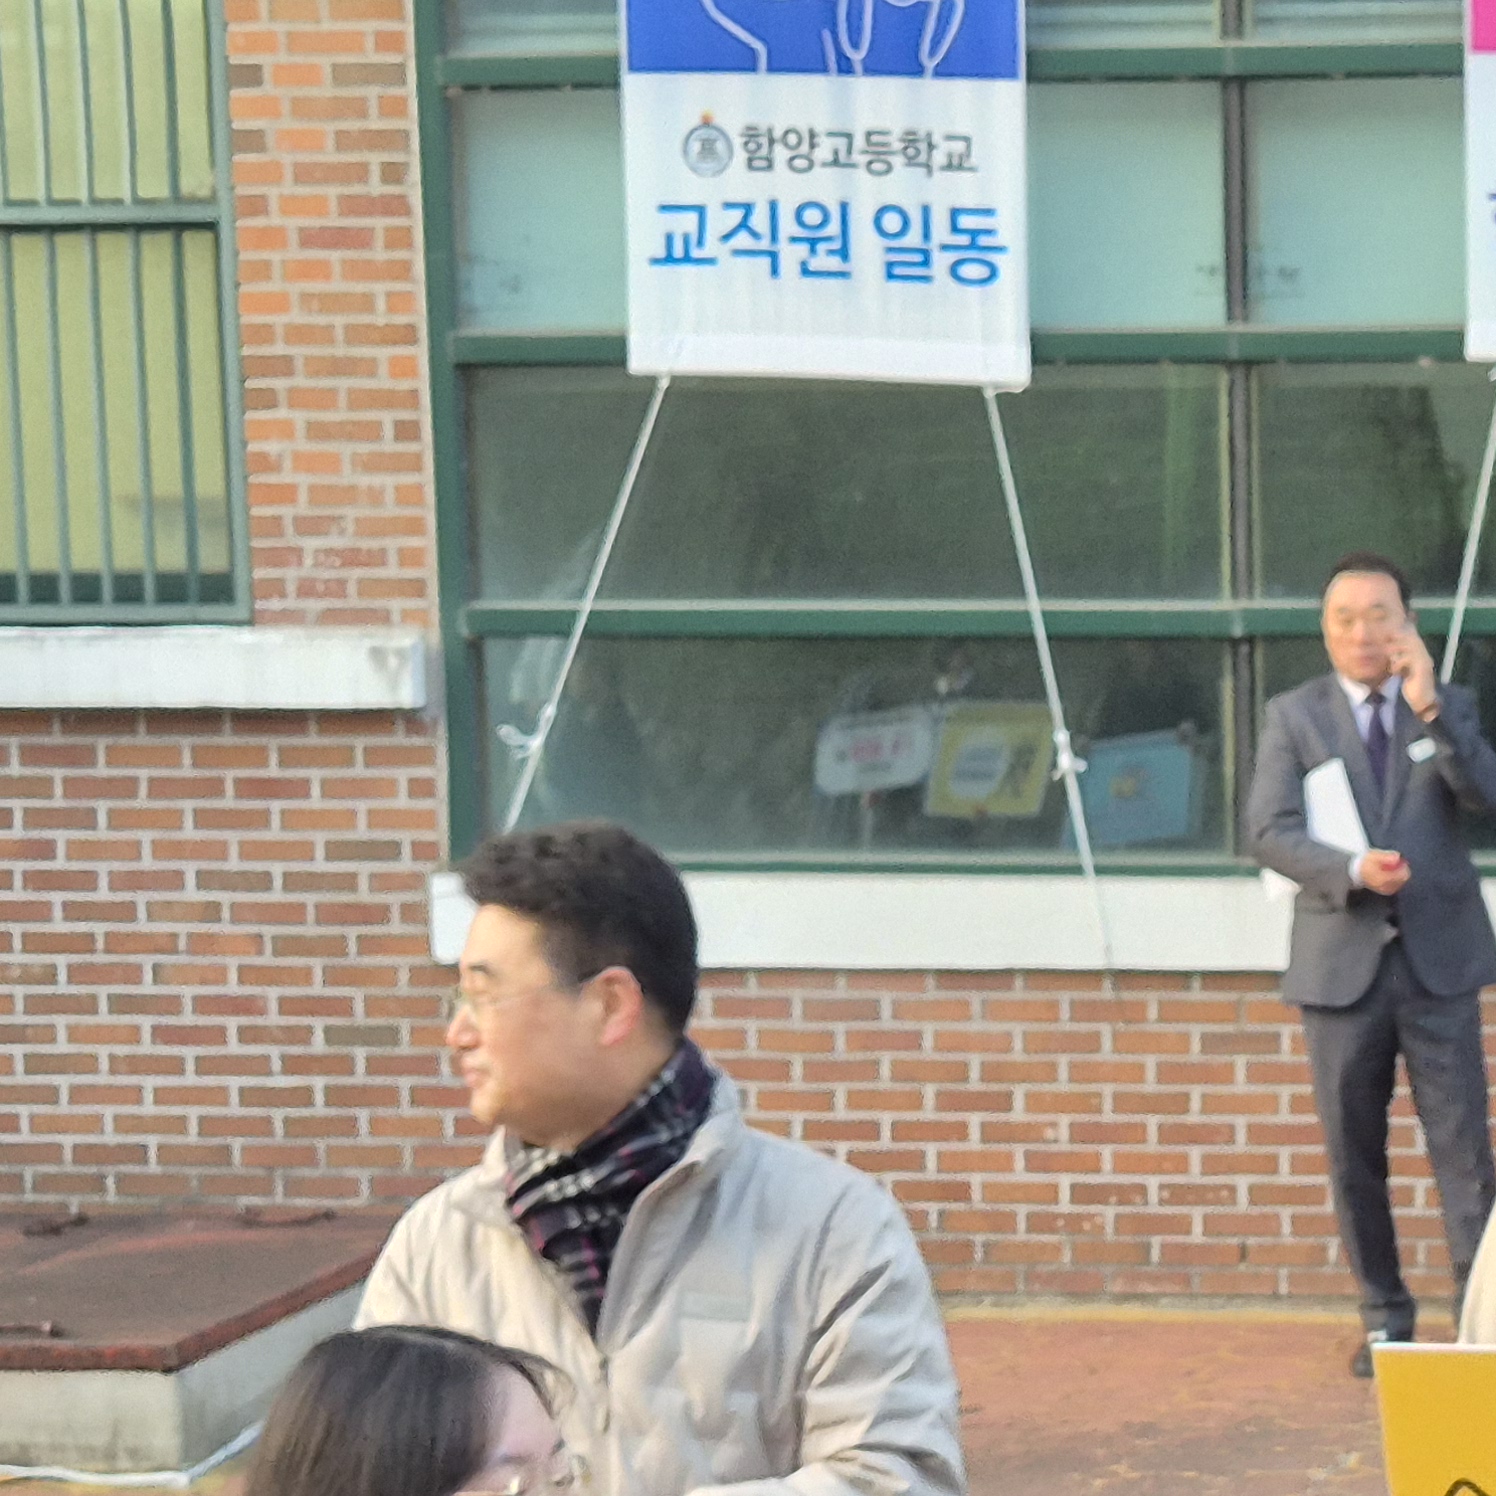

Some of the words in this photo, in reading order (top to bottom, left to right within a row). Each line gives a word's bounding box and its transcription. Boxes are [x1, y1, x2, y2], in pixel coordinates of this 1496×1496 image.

[740, 124, 979, 176] 함양고등학교
[648, 199, 853, 280] 교직원
[873, 202, 1008, 286] 일동
